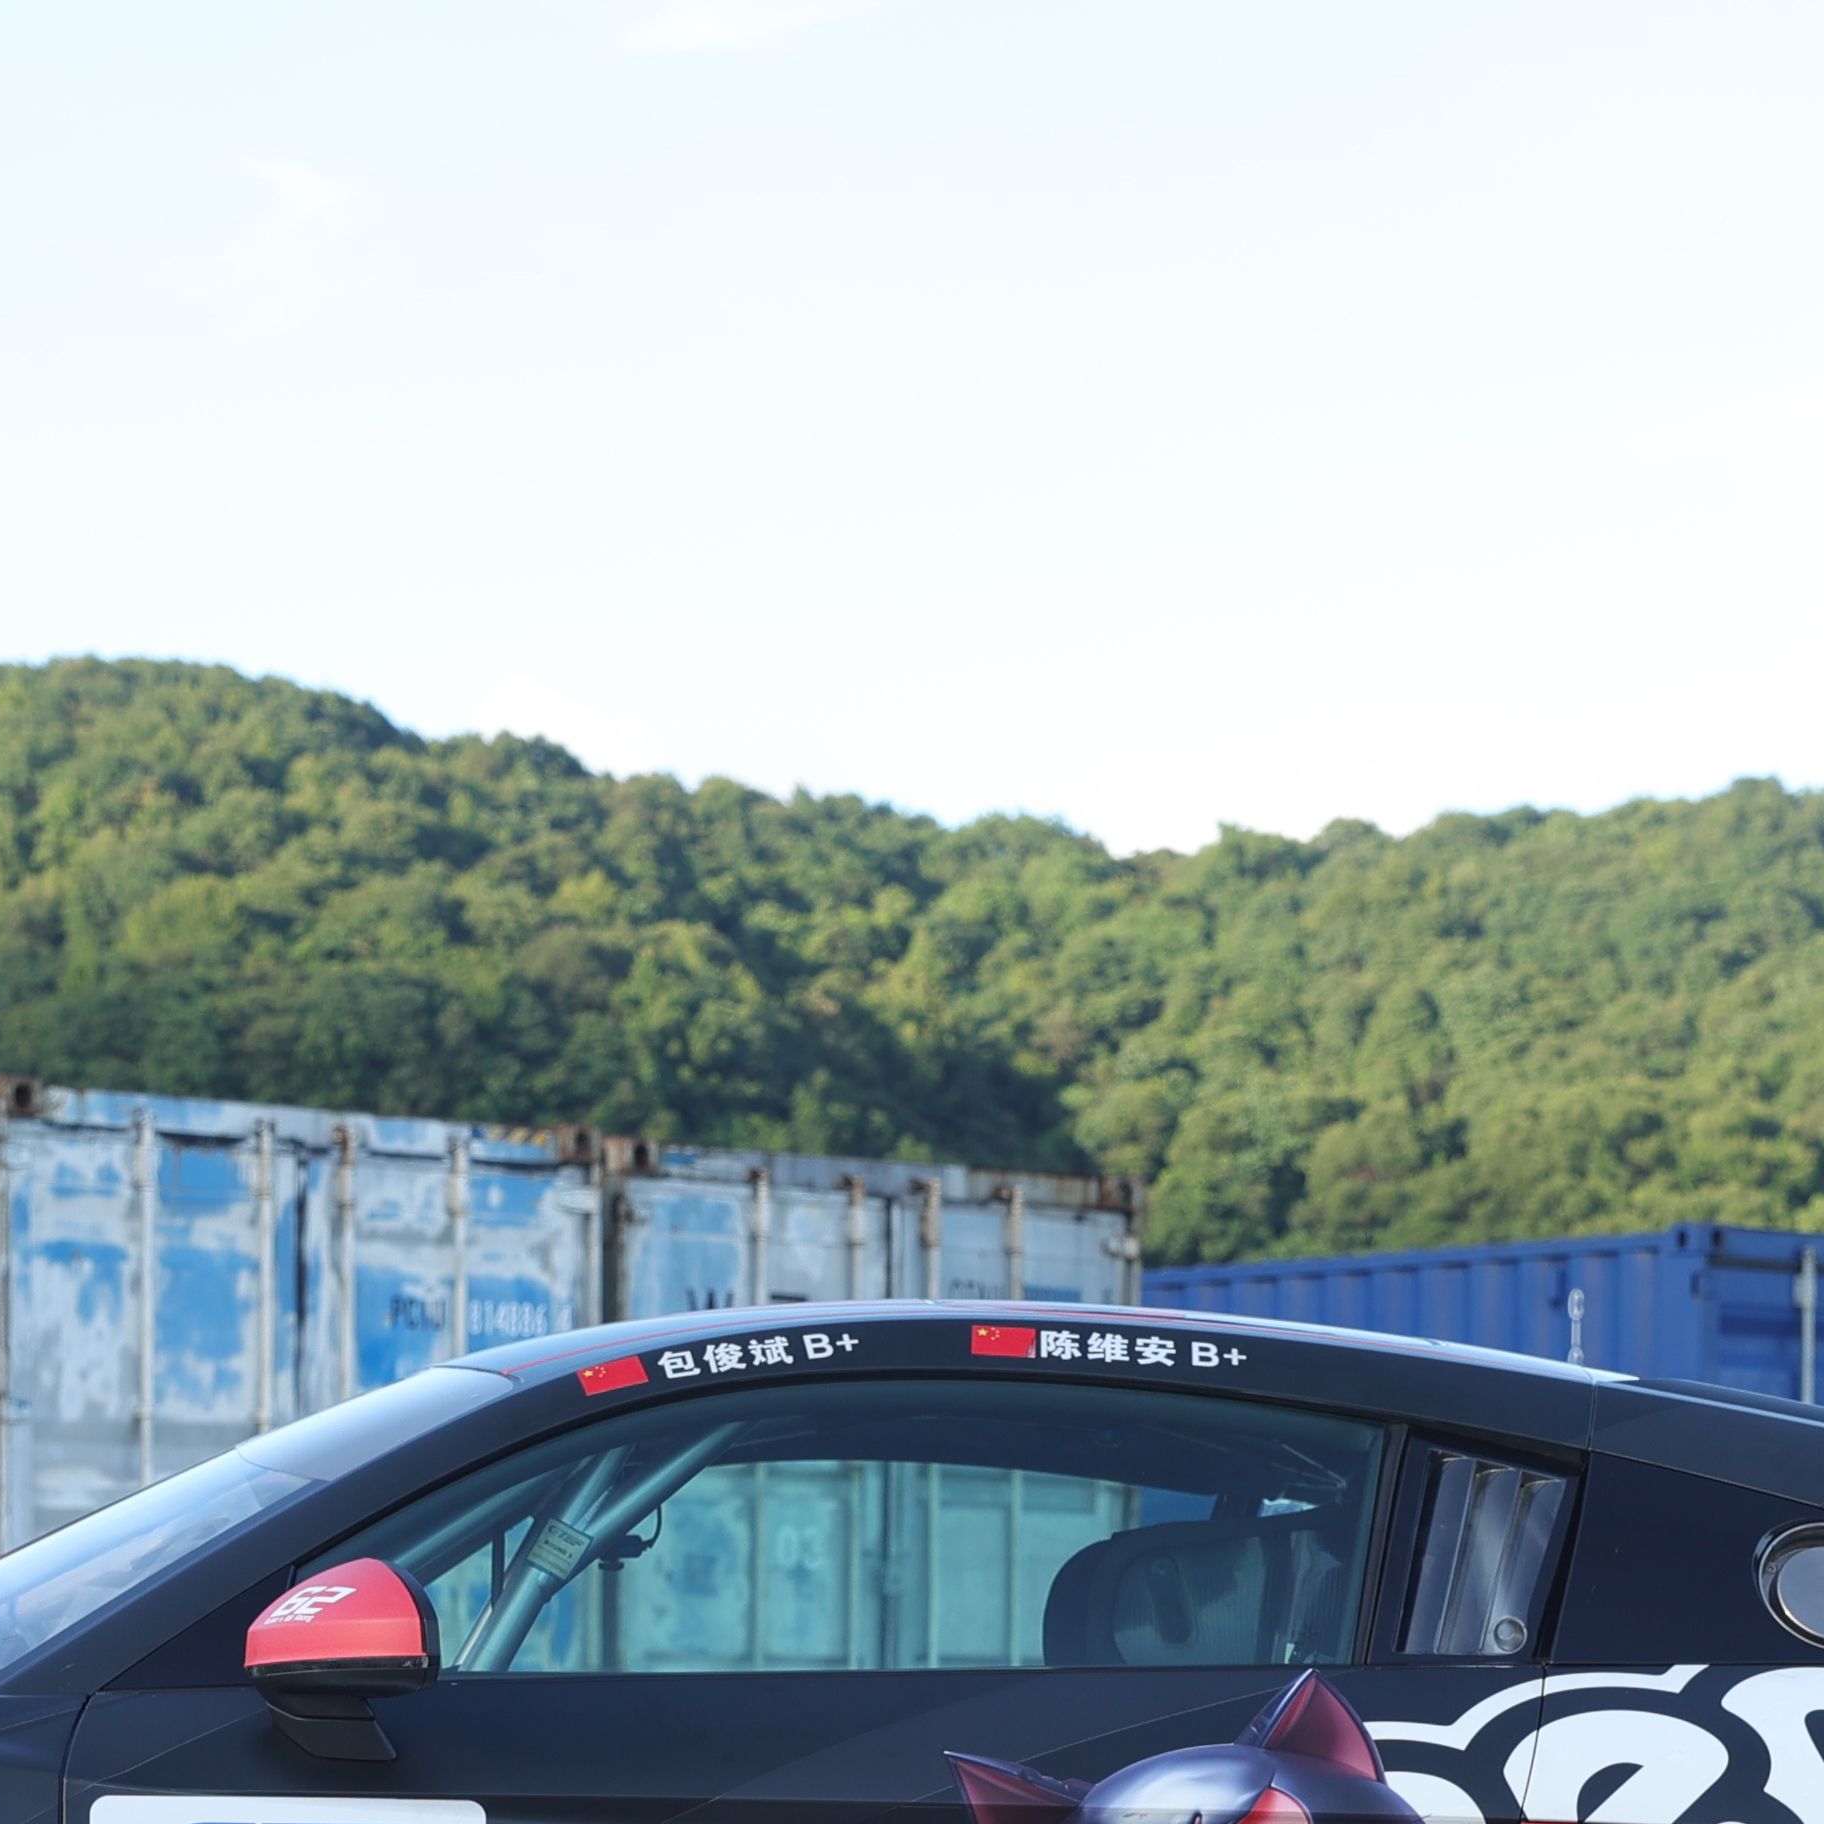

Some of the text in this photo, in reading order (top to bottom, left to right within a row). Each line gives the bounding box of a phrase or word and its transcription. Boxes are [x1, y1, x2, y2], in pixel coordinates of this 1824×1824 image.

[657, 1333, 860, 1379] 包俊斌 B+
[1039, 1330, 1247, 1368] 陈维安 B+
[270, 1585, 358, 1618] 62
